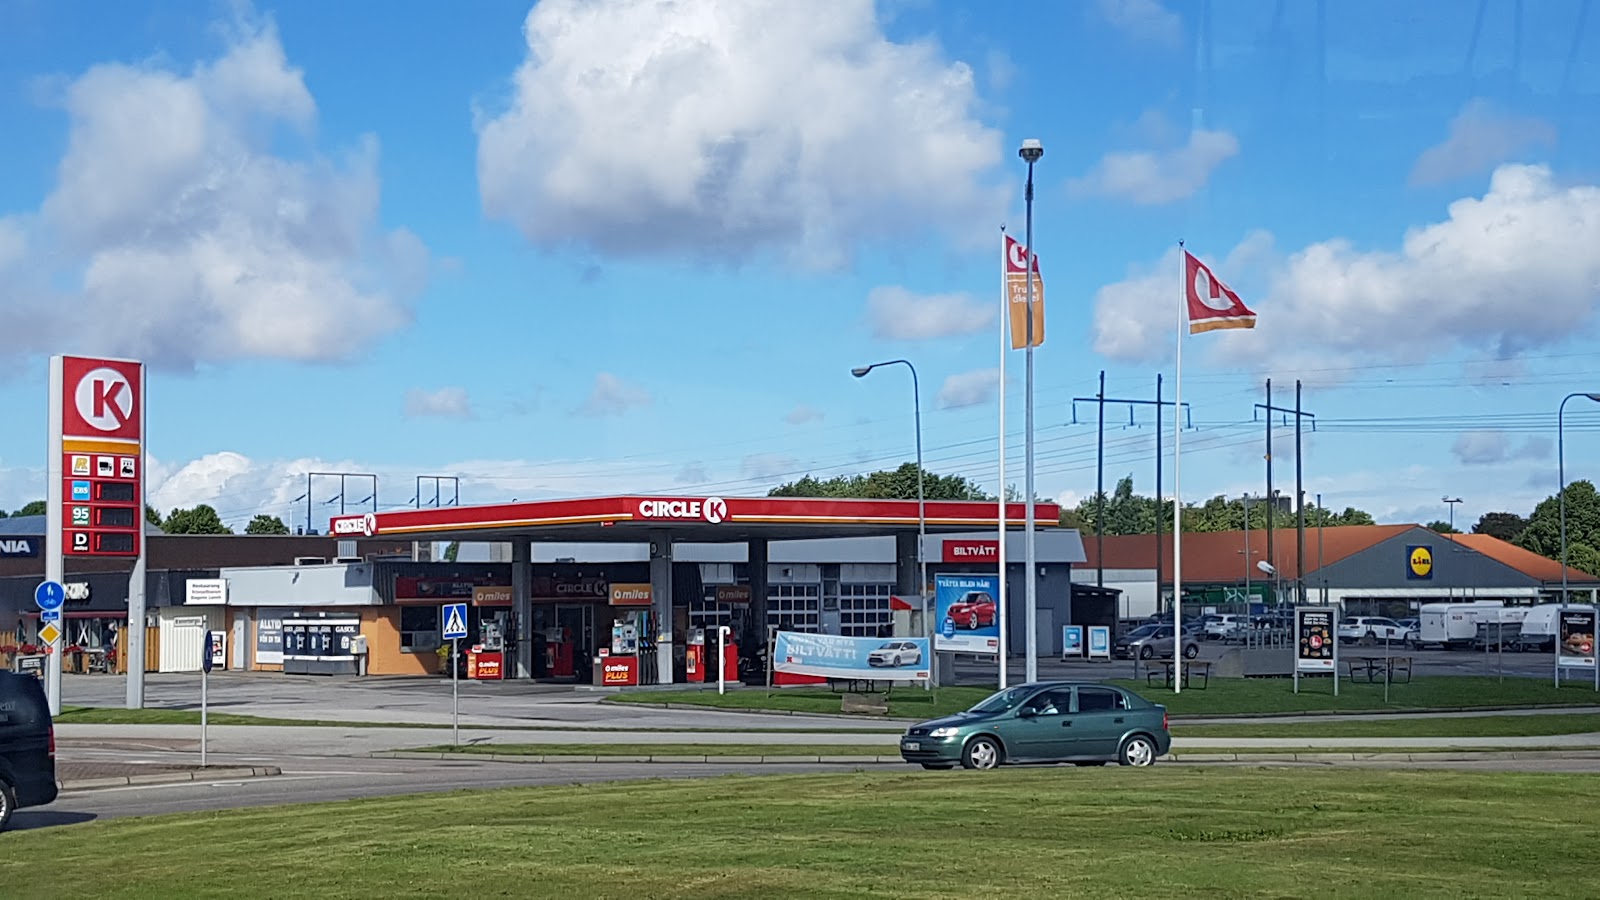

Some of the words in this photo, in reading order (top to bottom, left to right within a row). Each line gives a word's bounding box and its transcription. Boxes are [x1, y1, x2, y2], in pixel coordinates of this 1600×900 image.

[1012, 284, 1038, 293] Truk
[1012, 293, 1040, 303] dieel
[73, 507, 89, 519] 95
[639, 500, 701, 518] CIRCLE
[75, 533, 87, 545] D
[953, 545, 996, 556] BILTVÄTT
[556, 583, 593, 593] CIRCLE
[605, 671, 629, 680] PLUS
